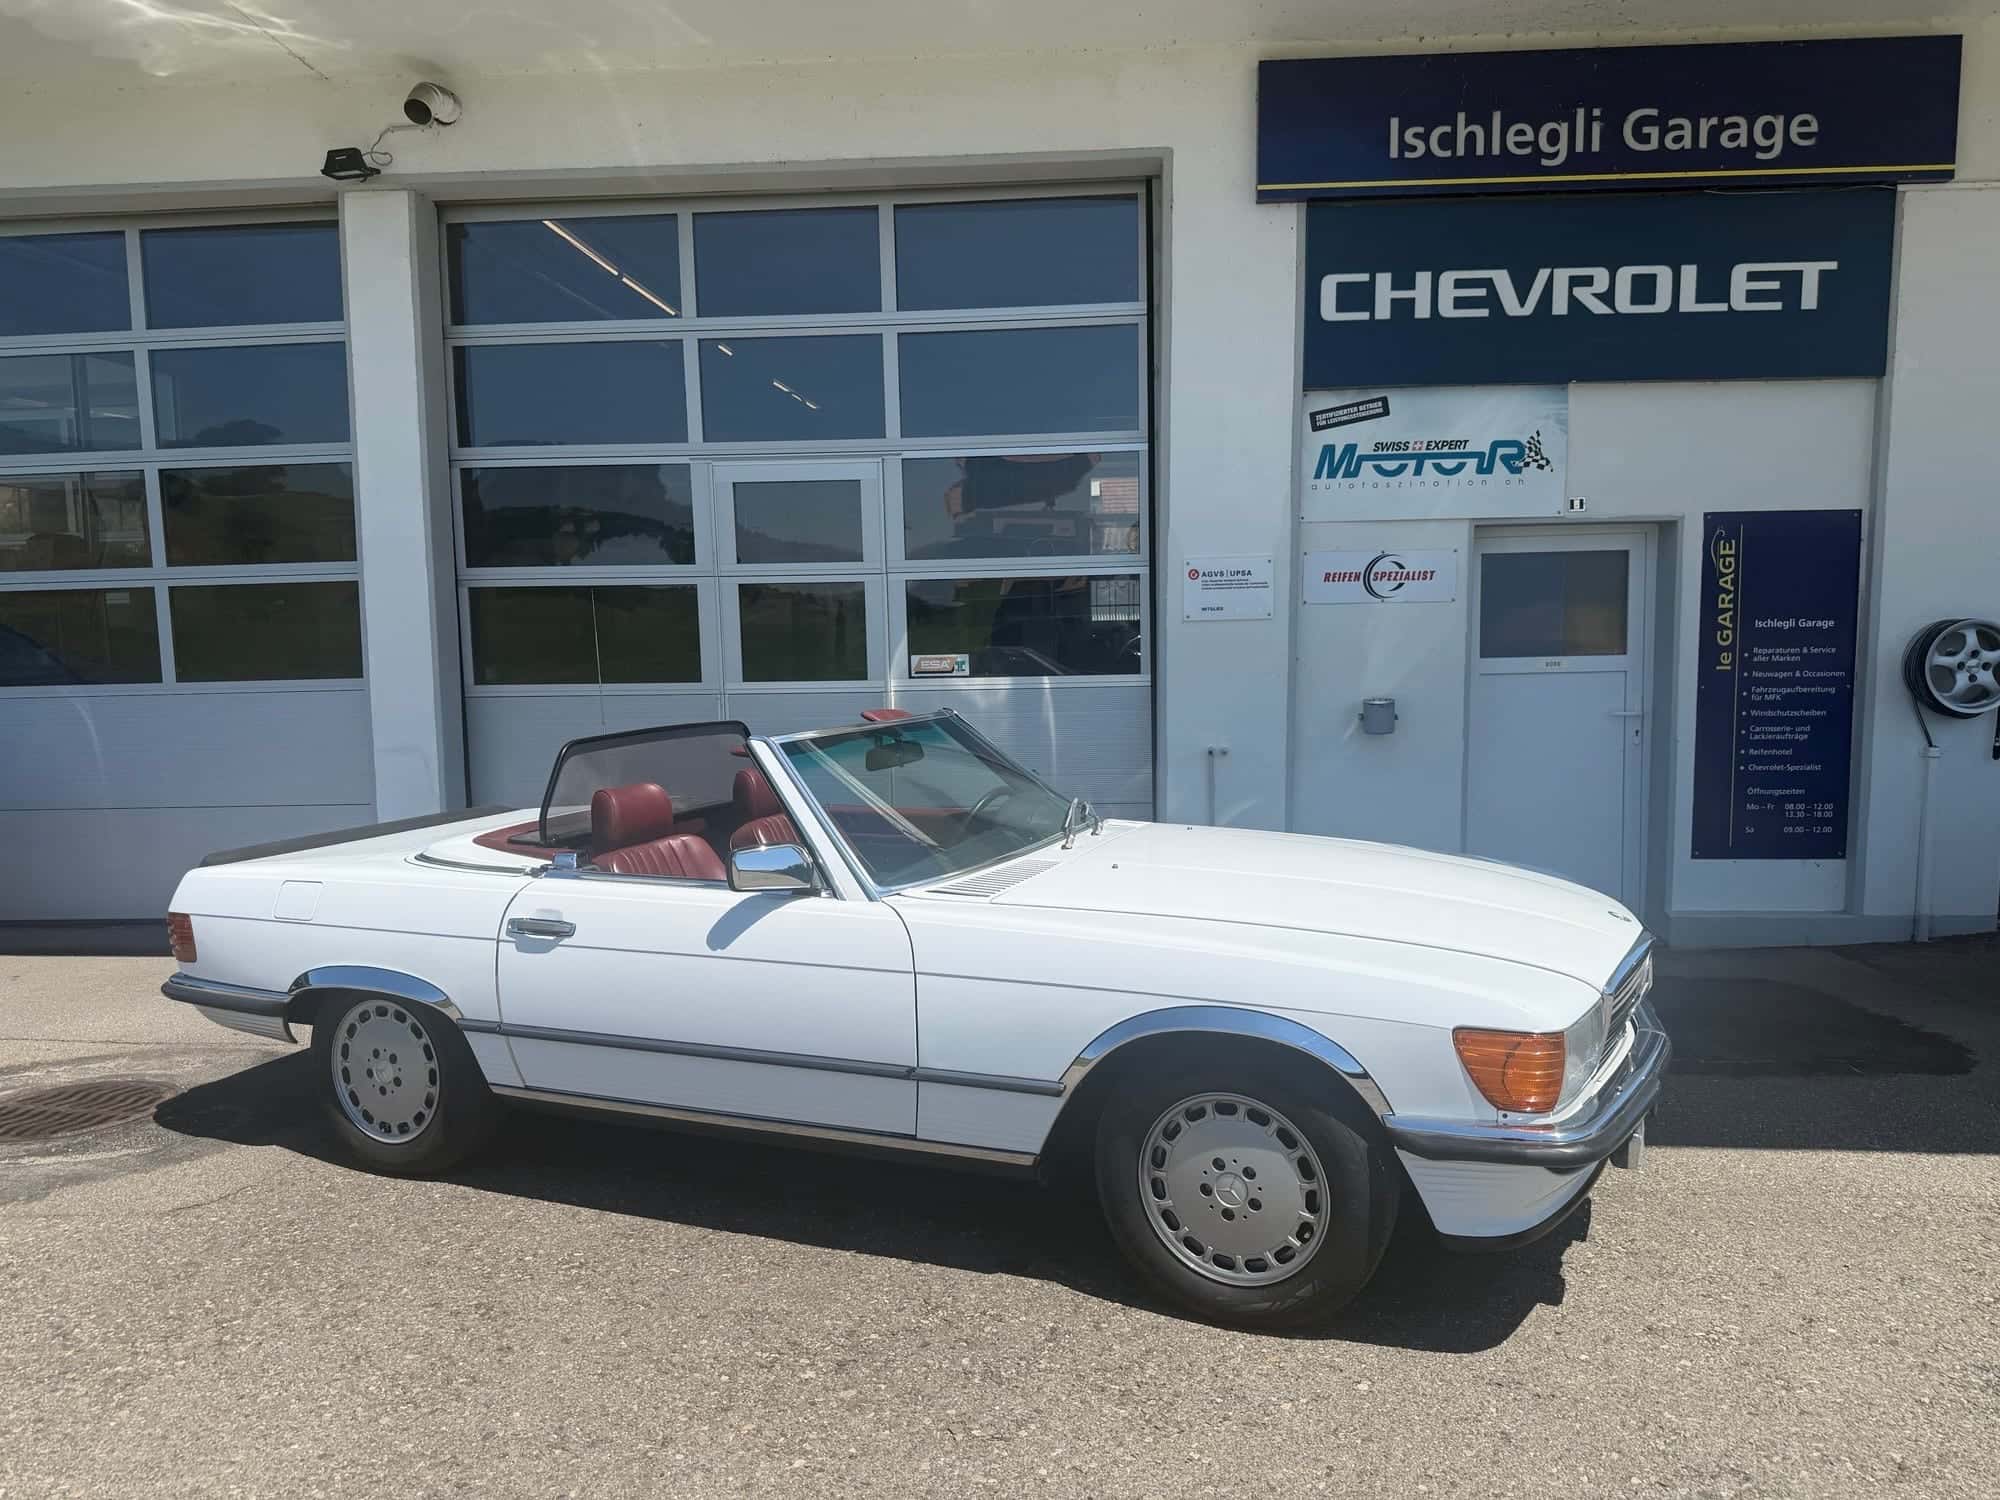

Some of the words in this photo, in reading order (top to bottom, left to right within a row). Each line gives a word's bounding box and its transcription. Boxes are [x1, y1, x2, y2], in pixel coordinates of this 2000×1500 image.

[1388, 107, 1602, 167] Ischlegli
[1621, 106, 1820, 161] Garage
[1319, 260, 1838, 323] CHEVROLET
[1373, 441, 1411, 453] SWISS
[1425, 439, 1470, 451] EXPERT
[1200, 570, 1225, 578] AGVS
[1323, 571, 1362, 584] REIFEN
[1371, 569, 1436, 583] SPEZIALIST
[1716, 539, 1736, 646] GARAGE
[1755, 618, 1797, 630] Ischlegli
[1798, 618, 1836, 629] Garage
[1753, 647, 1801, 655] Reparaturen
[1810, 646, 1837, 654] Service
[1771, 654, 1801, 662] Marken
[1751, 670, 1793, 679] Neuwagen
[1802, 669, 1846, 677] Occasionen
[1795, 724, 1811, 732] und
